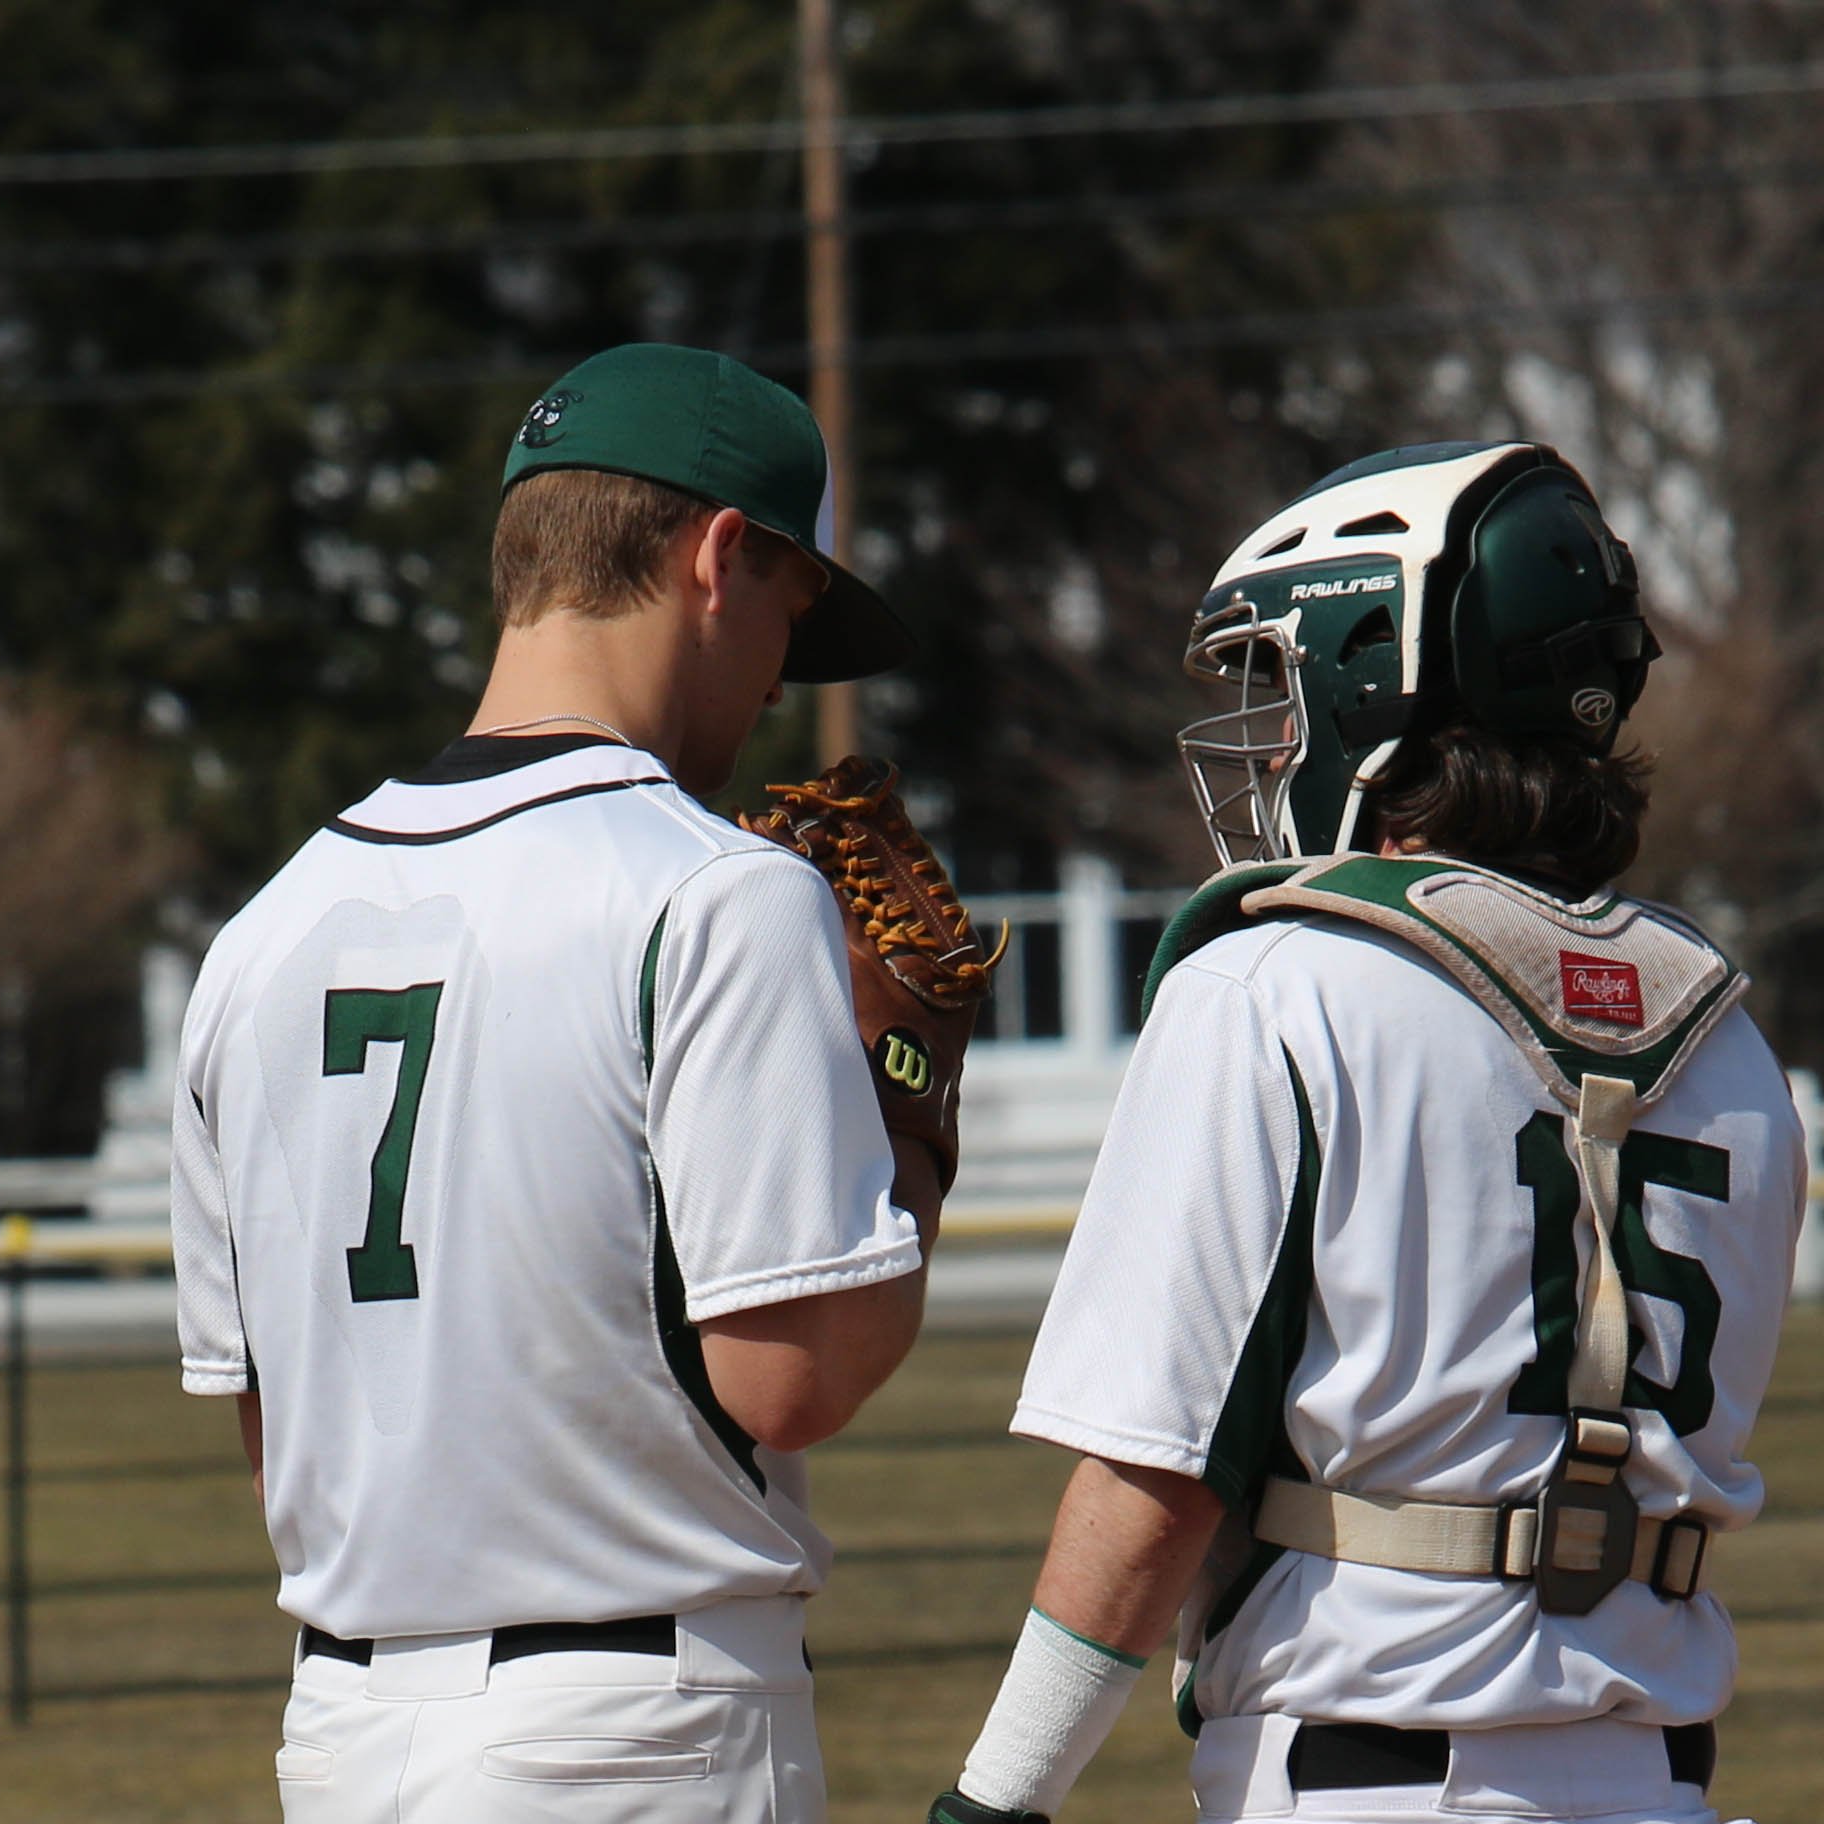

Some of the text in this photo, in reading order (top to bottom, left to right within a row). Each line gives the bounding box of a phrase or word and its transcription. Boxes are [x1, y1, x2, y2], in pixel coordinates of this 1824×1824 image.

[1290, 573, 1398, 601] RAWLINGS
[321, 981, 446, 1304] 7
[1506, 1108, 1731, 1438] 15
